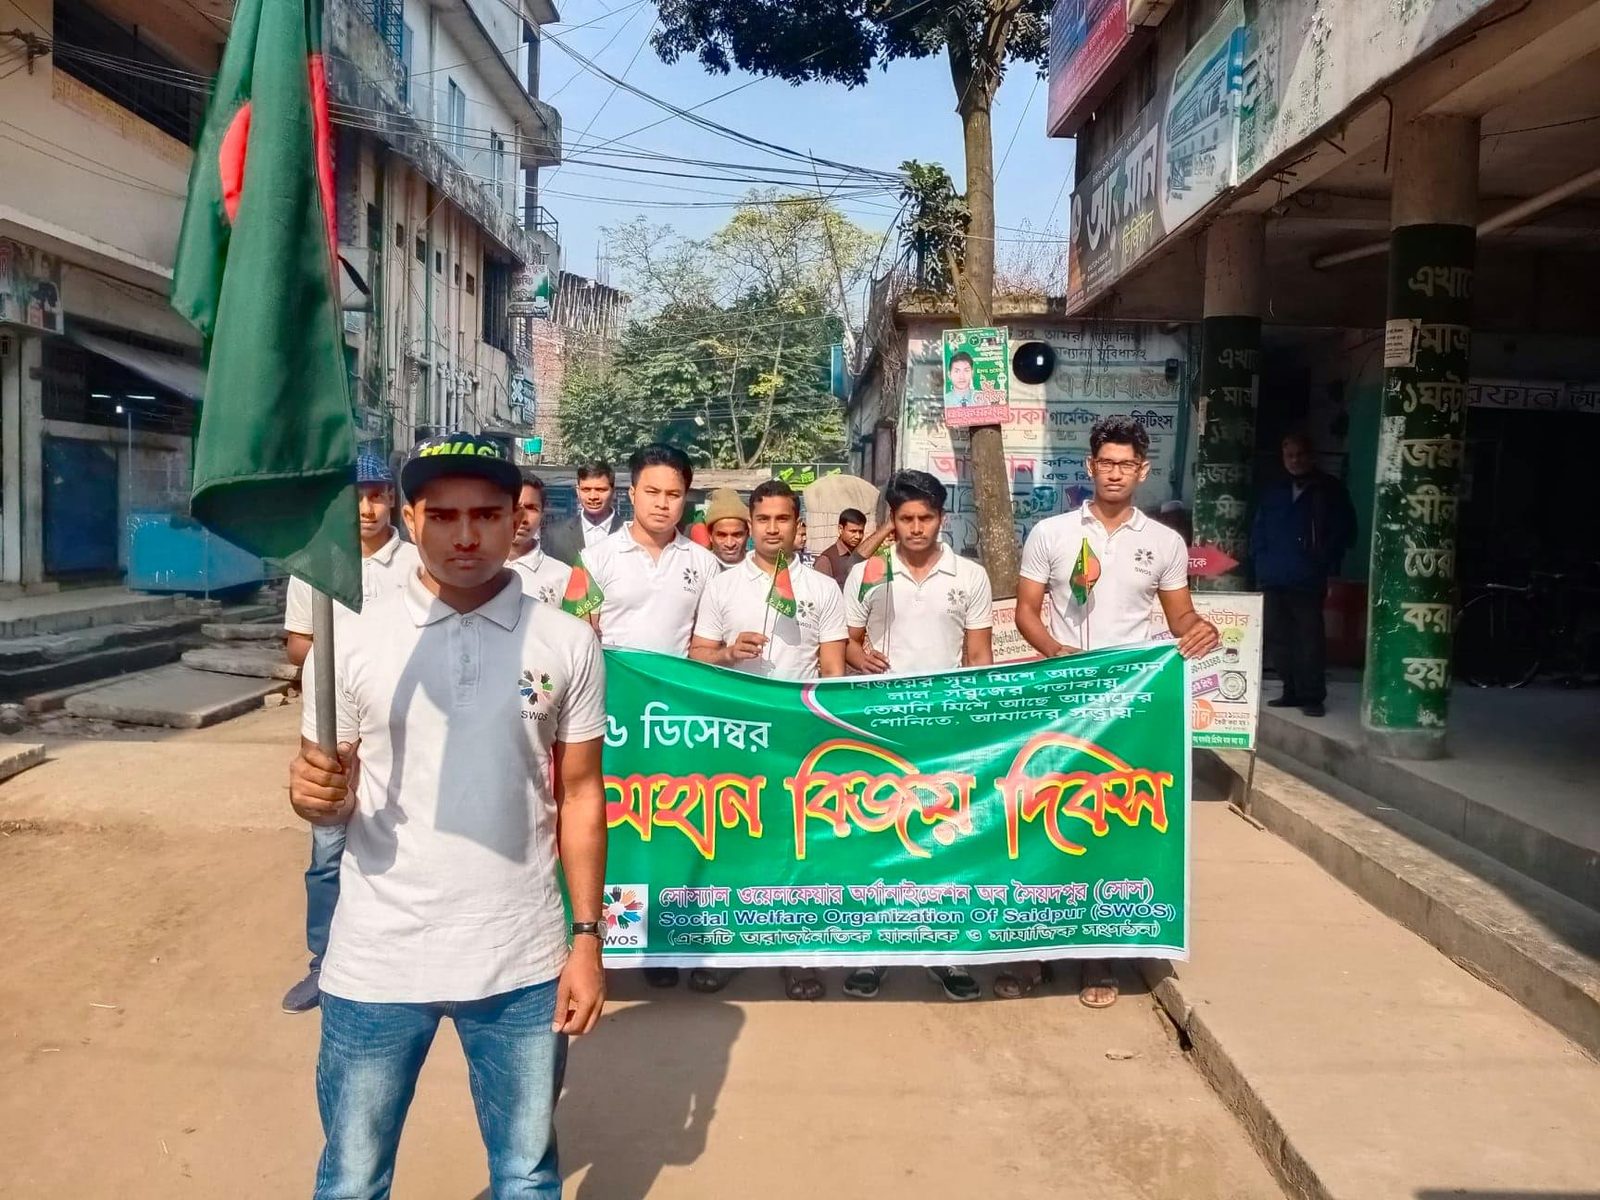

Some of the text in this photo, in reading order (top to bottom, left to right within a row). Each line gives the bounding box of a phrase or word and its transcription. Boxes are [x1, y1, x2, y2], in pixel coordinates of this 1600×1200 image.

[1045, 666, 1100, 679] আছে
[1107, 661, 1168, 674] যেমন
[864, 691, 1155, 715] তেমনি মিশে আছে আমাদের
[520, 710, 549, 721] SWOS
[640, 701, 772, 752] ডিসেম্বর
[969, 708, 1062, 723] আমাদের
[605, 731, 1173, 861] মহান বিজয় দিবস
[974, 884, 1009, 906] অব
[1011, 879, 1089, 906] সৈয়দপুর
[659, 903, 1177, 927] Social Welfare Organization Of Saidpur (SWOS)
[605, 934, 639, 945] WOS
[668, 928, 734, 946] (একটি
[740, 926, 872, 946] অরাজনৈতিক
[878, 925, 959, 944] মানবিক
[966, 929, 982, 942] ও
[989, 923, 1077, 943] সামাজিক
